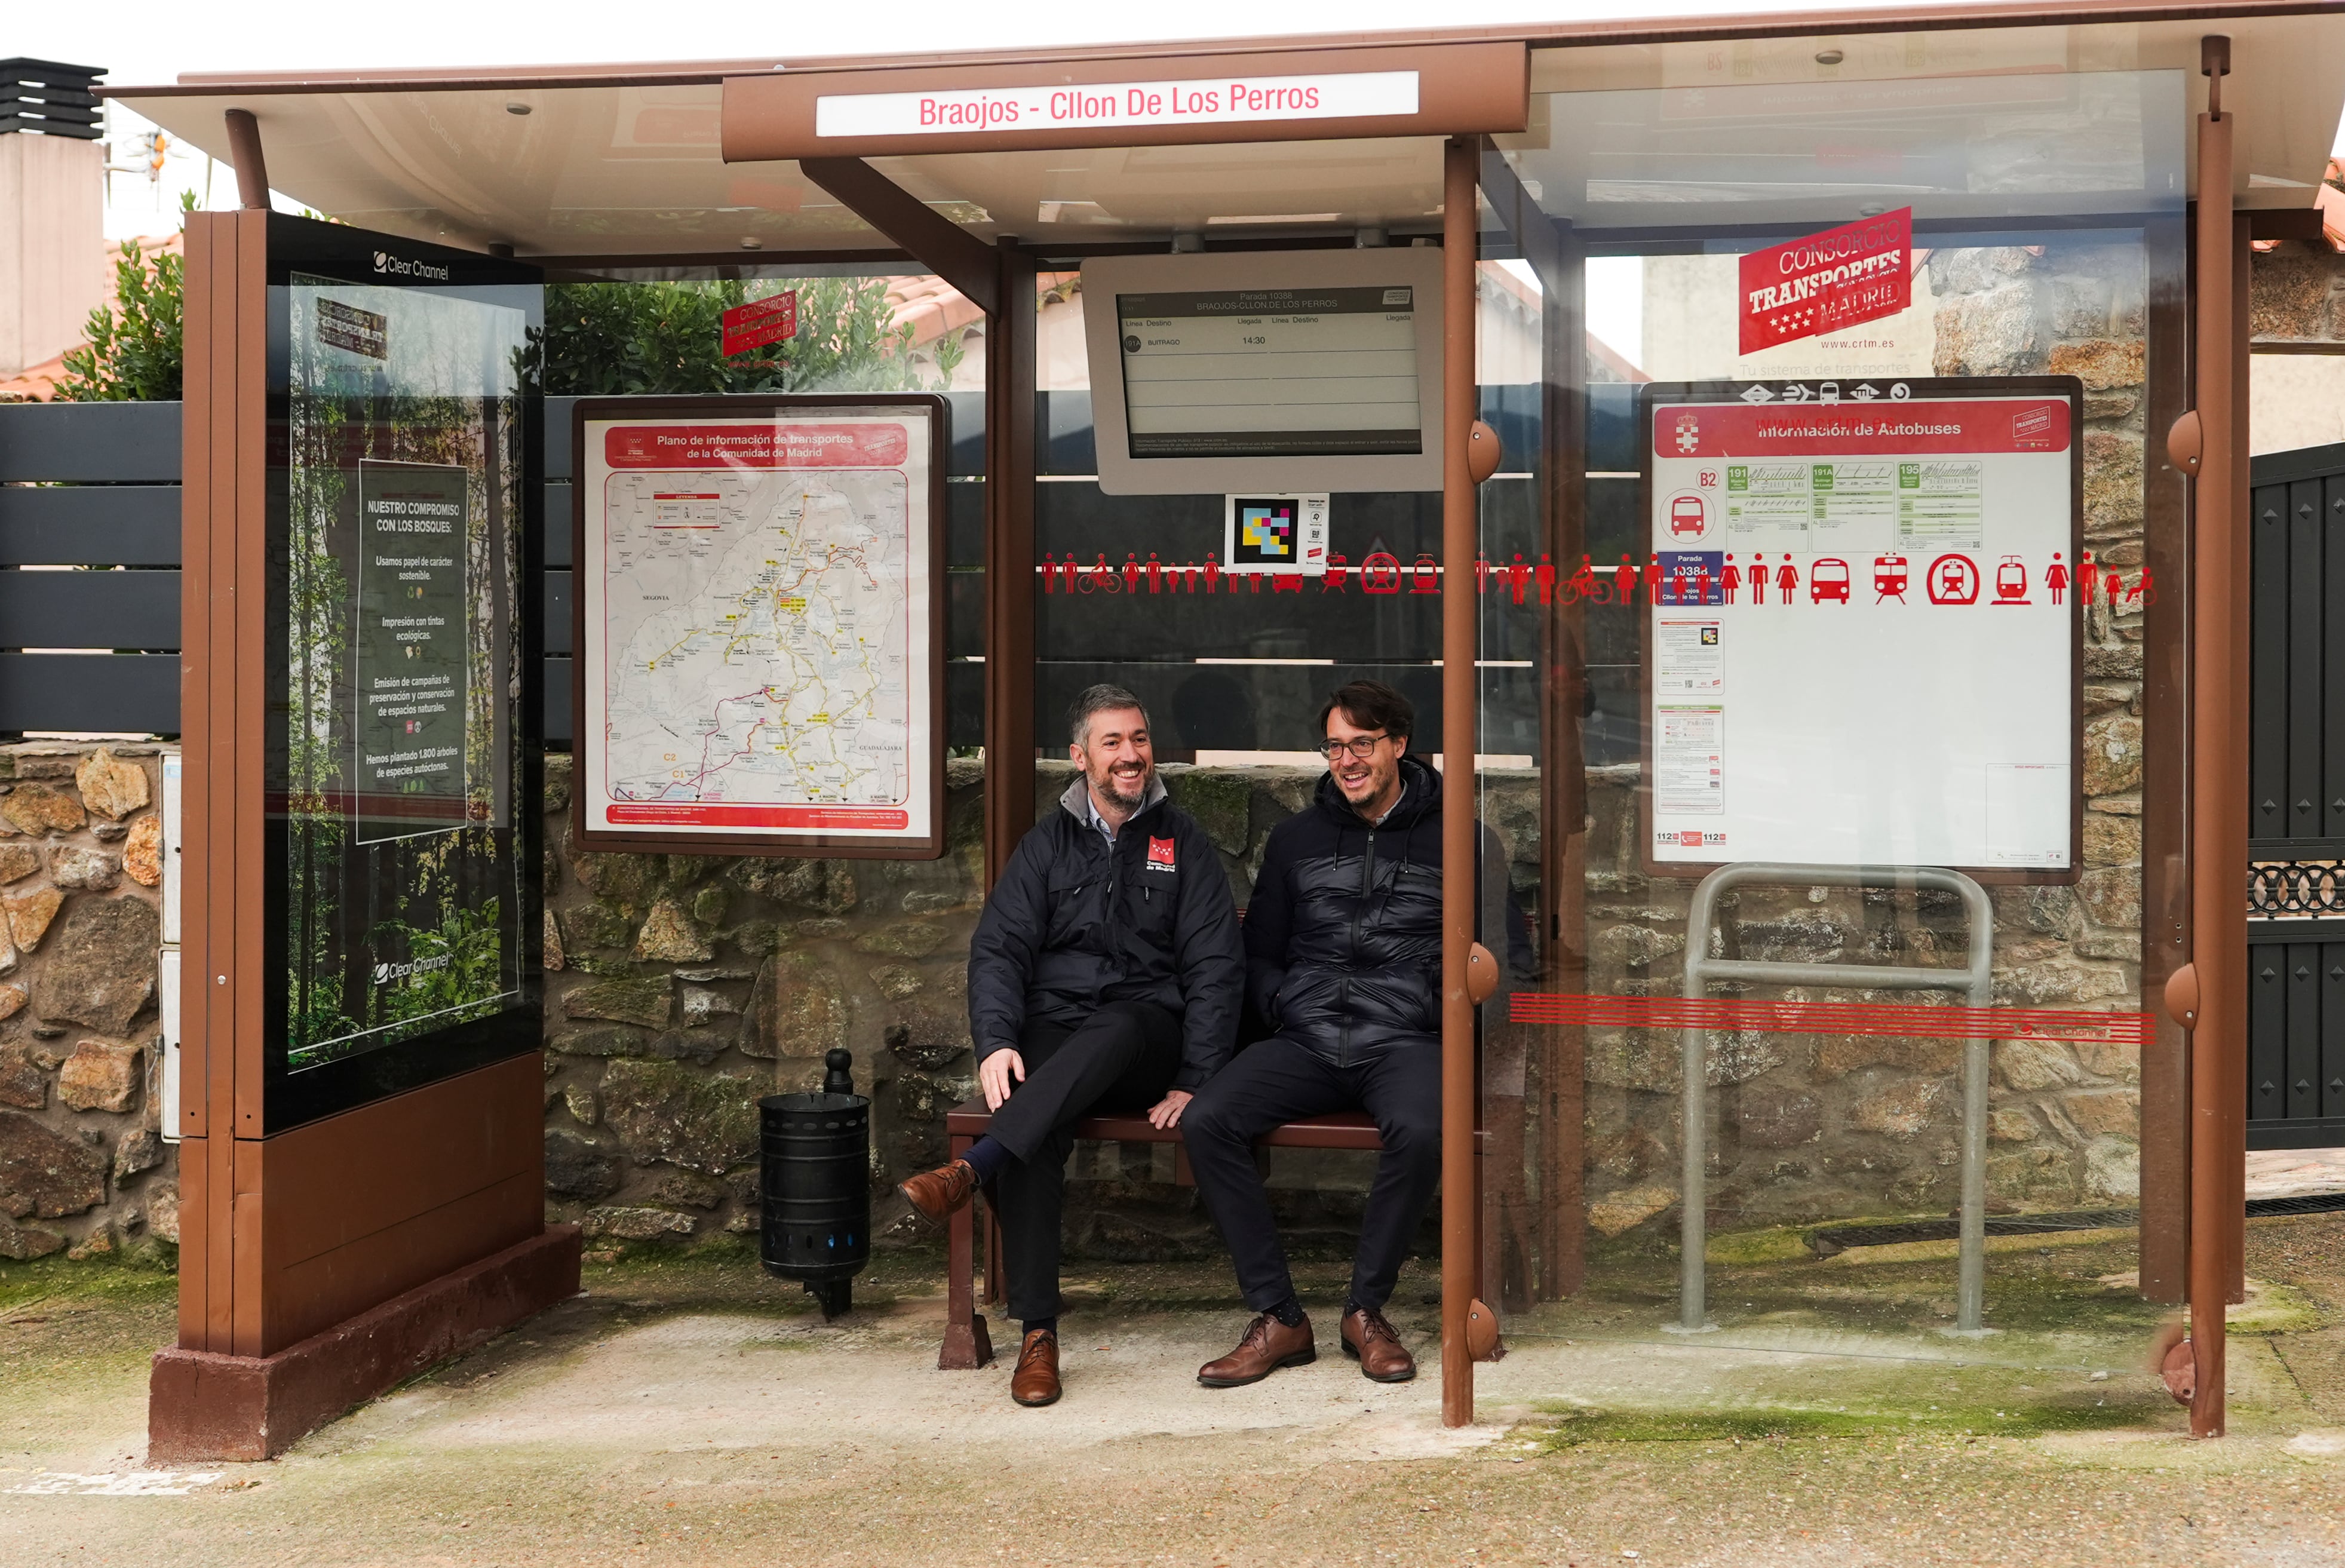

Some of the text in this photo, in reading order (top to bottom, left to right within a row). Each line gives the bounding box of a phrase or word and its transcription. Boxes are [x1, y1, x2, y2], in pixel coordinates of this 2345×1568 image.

[919, 96, 1018, 130] Braojos
[1050, 91, 1116, 119] Cllon
[1127, 90, 1162, 116] De
[1171, 88, 1219, 115] Los
[1229, 84, 1319, 112] Perros
[1779, 219, 1902, 275] CONSORCIO
[387, 256, 449, 281] Clear Channel
[1749, 248, 1901, 314] TRANSPORTES
[740, 295, 792, 320] CONSORCIO
[727, 309, 792, 338] TRANSPORTES
[757, 323, 792, 343] MADRID
[1242, 336, 1266, 345] 14:30
[1821, 339, 1895, 349] www.crtm.es
[1739, 363, 1911, 377] Tu sistema de transportes
[1855, 422, 1874, 436] de
[1877, 421, 1962, 437] Autobuses
[657, 433, 854, 446] Plano de información de transportes
[687, 448, 822, 458] de la Comunidad de Madrid
[1729, 468, 1747, 477] 191
[1901, 465, 1919, 475] 195
[1700, 472, 1716, 486] B2
[368, 501, 459, 516] NUESTRO COMPROMISO
[376, 518, 452, 533] CON LOS BOSQUES:
[376, 556, 453, 569] Usamos papel de carácter
[398, 569, 431, 581] sostenible.
[382, 616, 445, 628] Impresión con tintas
[396, 629, 431, 642] ecológicas.
[374, 674, 450, 689] Emisión de campañas de
[369, 688, 455, 705] preservación y conservación
[377, 702, 447, 718] de espacios naturales.
[366, 753, 389, 765] Hemos
[389, 750, 418, 765] plantado
[436, 745, 458, 759] árboles
[376, 761, 449, 779] de especies autóctonas.
[389, 952, 449, 979] Clear Channel
[2035, 1026, 2107, 1037] Clear Channel
